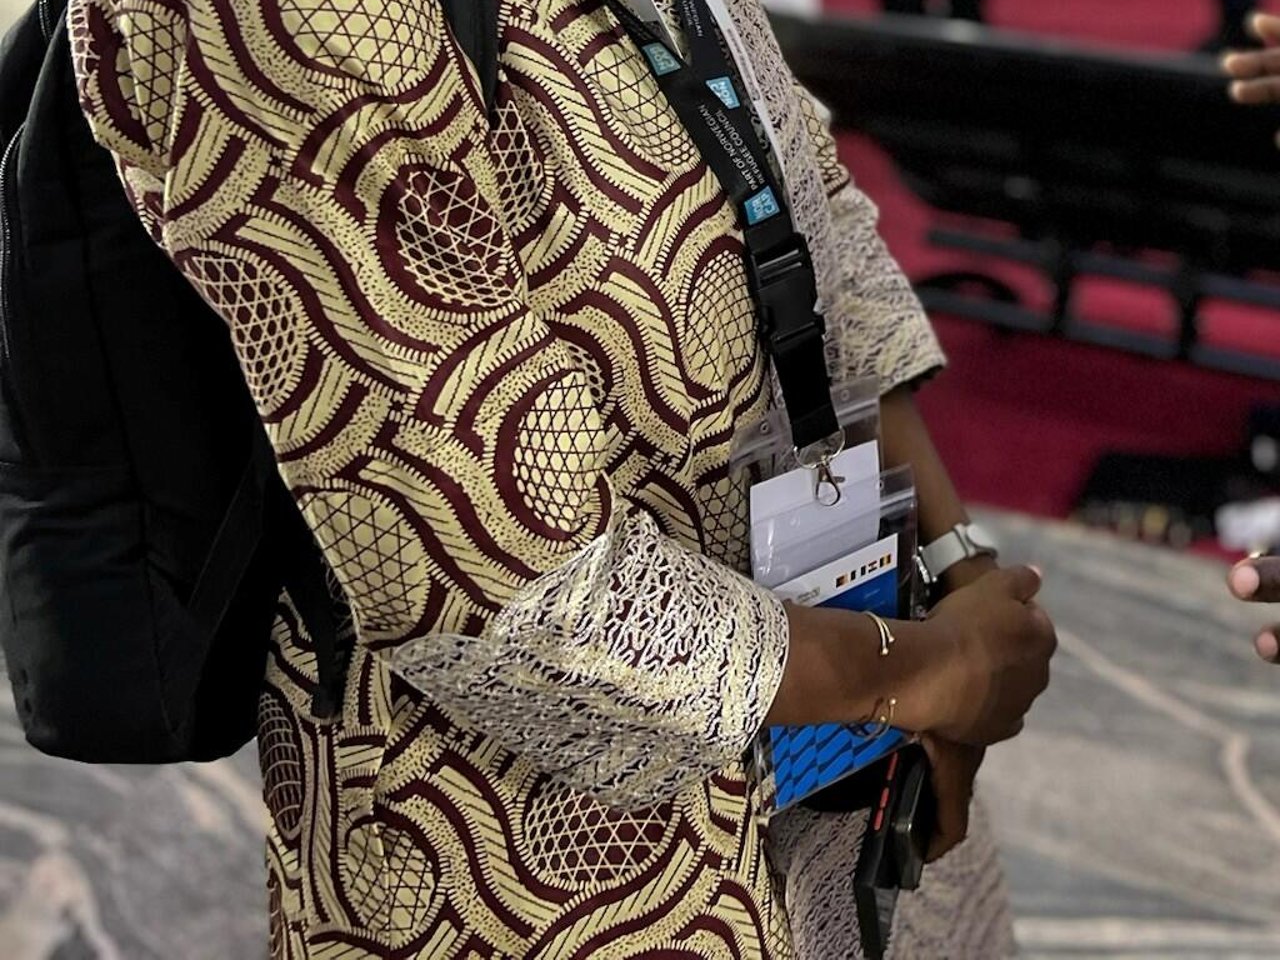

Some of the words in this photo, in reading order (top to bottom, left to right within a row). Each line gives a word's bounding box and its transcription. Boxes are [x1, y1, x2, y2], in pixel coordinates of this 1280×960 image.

[700, 104, 735, 156] NORWEGIAN
[732, 155, 745, 170] OF
[741, 169, 759, 191] PART
